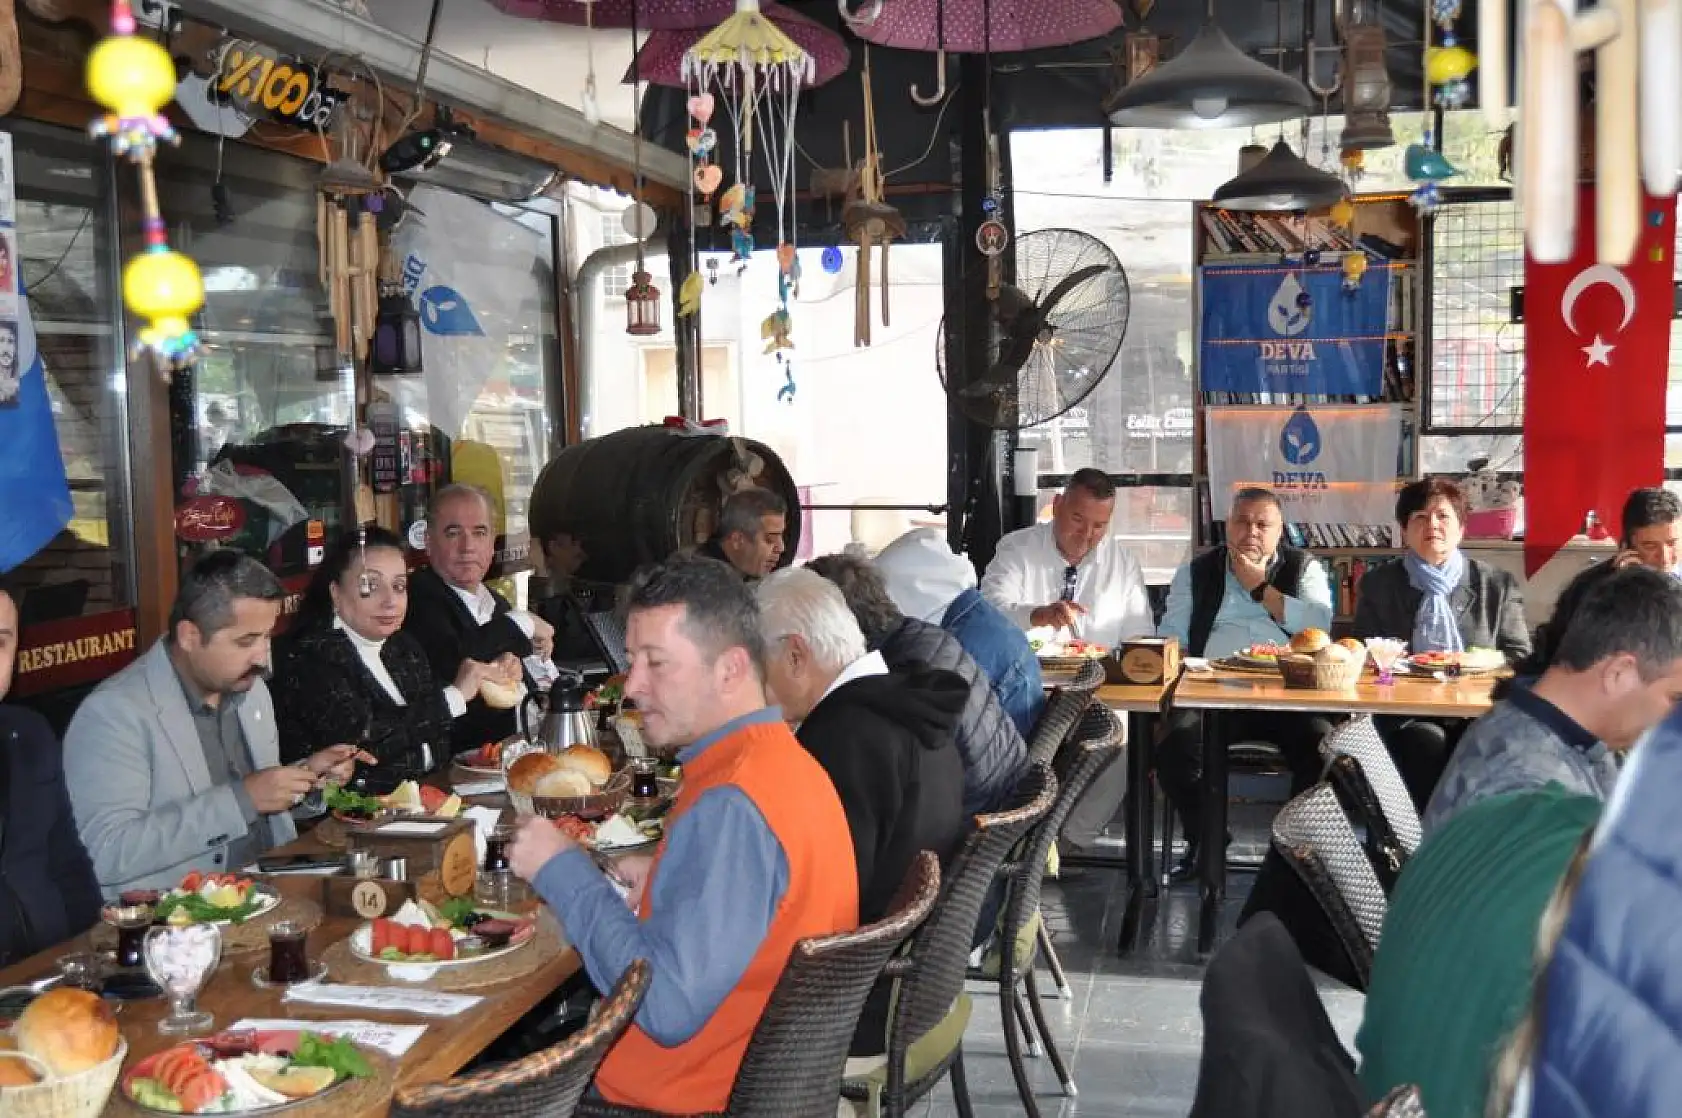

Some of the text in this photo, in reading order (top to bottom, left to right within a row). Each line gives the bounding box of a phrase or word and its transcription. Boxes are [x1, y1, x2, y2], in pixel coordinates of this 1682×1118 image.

[1260, 342, 1317, 360] DEVA
[1271, 470, 1329, 490] DEVA
[18, 628, 136, 674] RESTAURANT
[361, 890, 379, 909] 14
